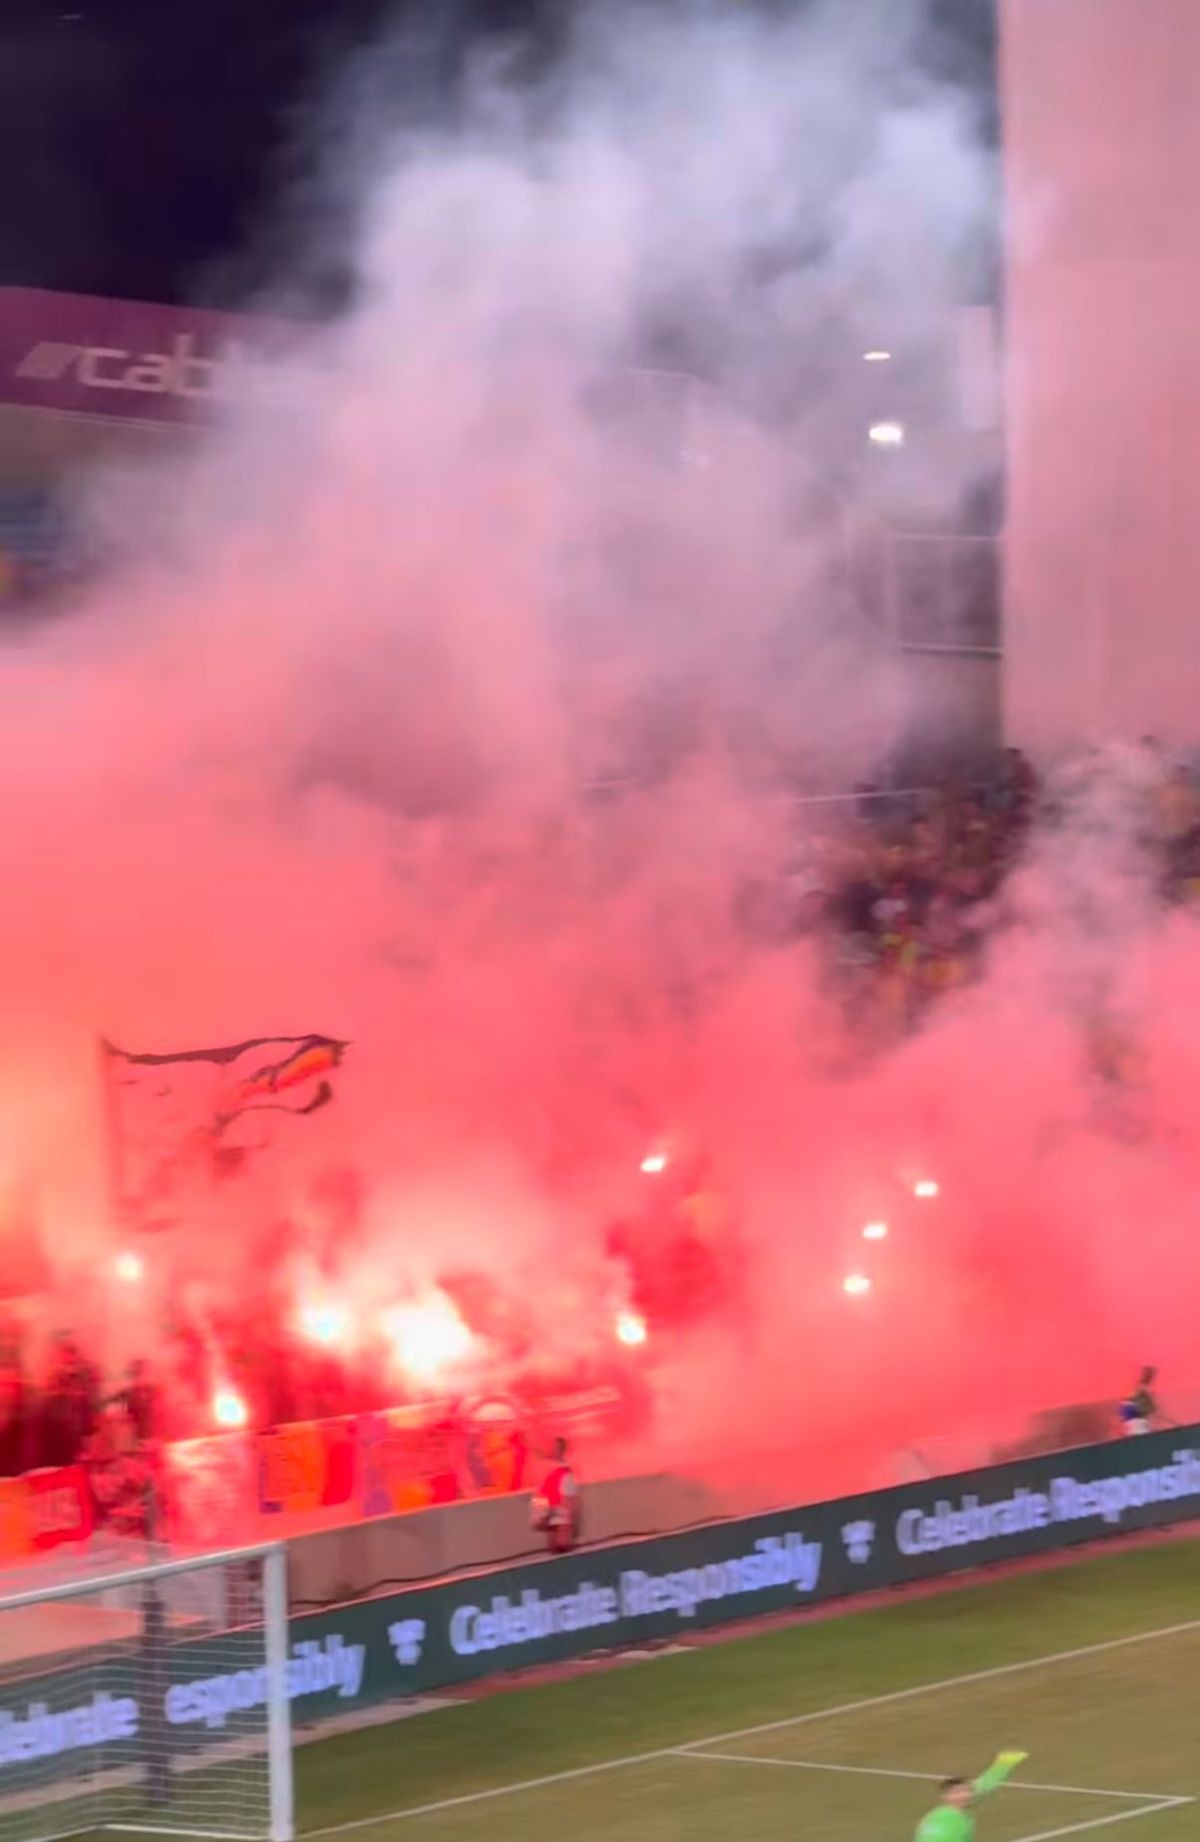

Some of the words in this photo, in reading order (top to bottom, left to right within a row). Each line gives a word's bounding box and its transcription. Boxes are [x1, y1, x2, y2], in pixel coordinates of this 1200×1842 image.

[77, 332, 226, 398] cab
[896, 1486, 1048, 1556] Celebrate
[449, 1588, 618, 1655] Celebrate
[620, 1532, 822, 1617] Responsibly
[0, 1691, 139, 1764] lebrate
